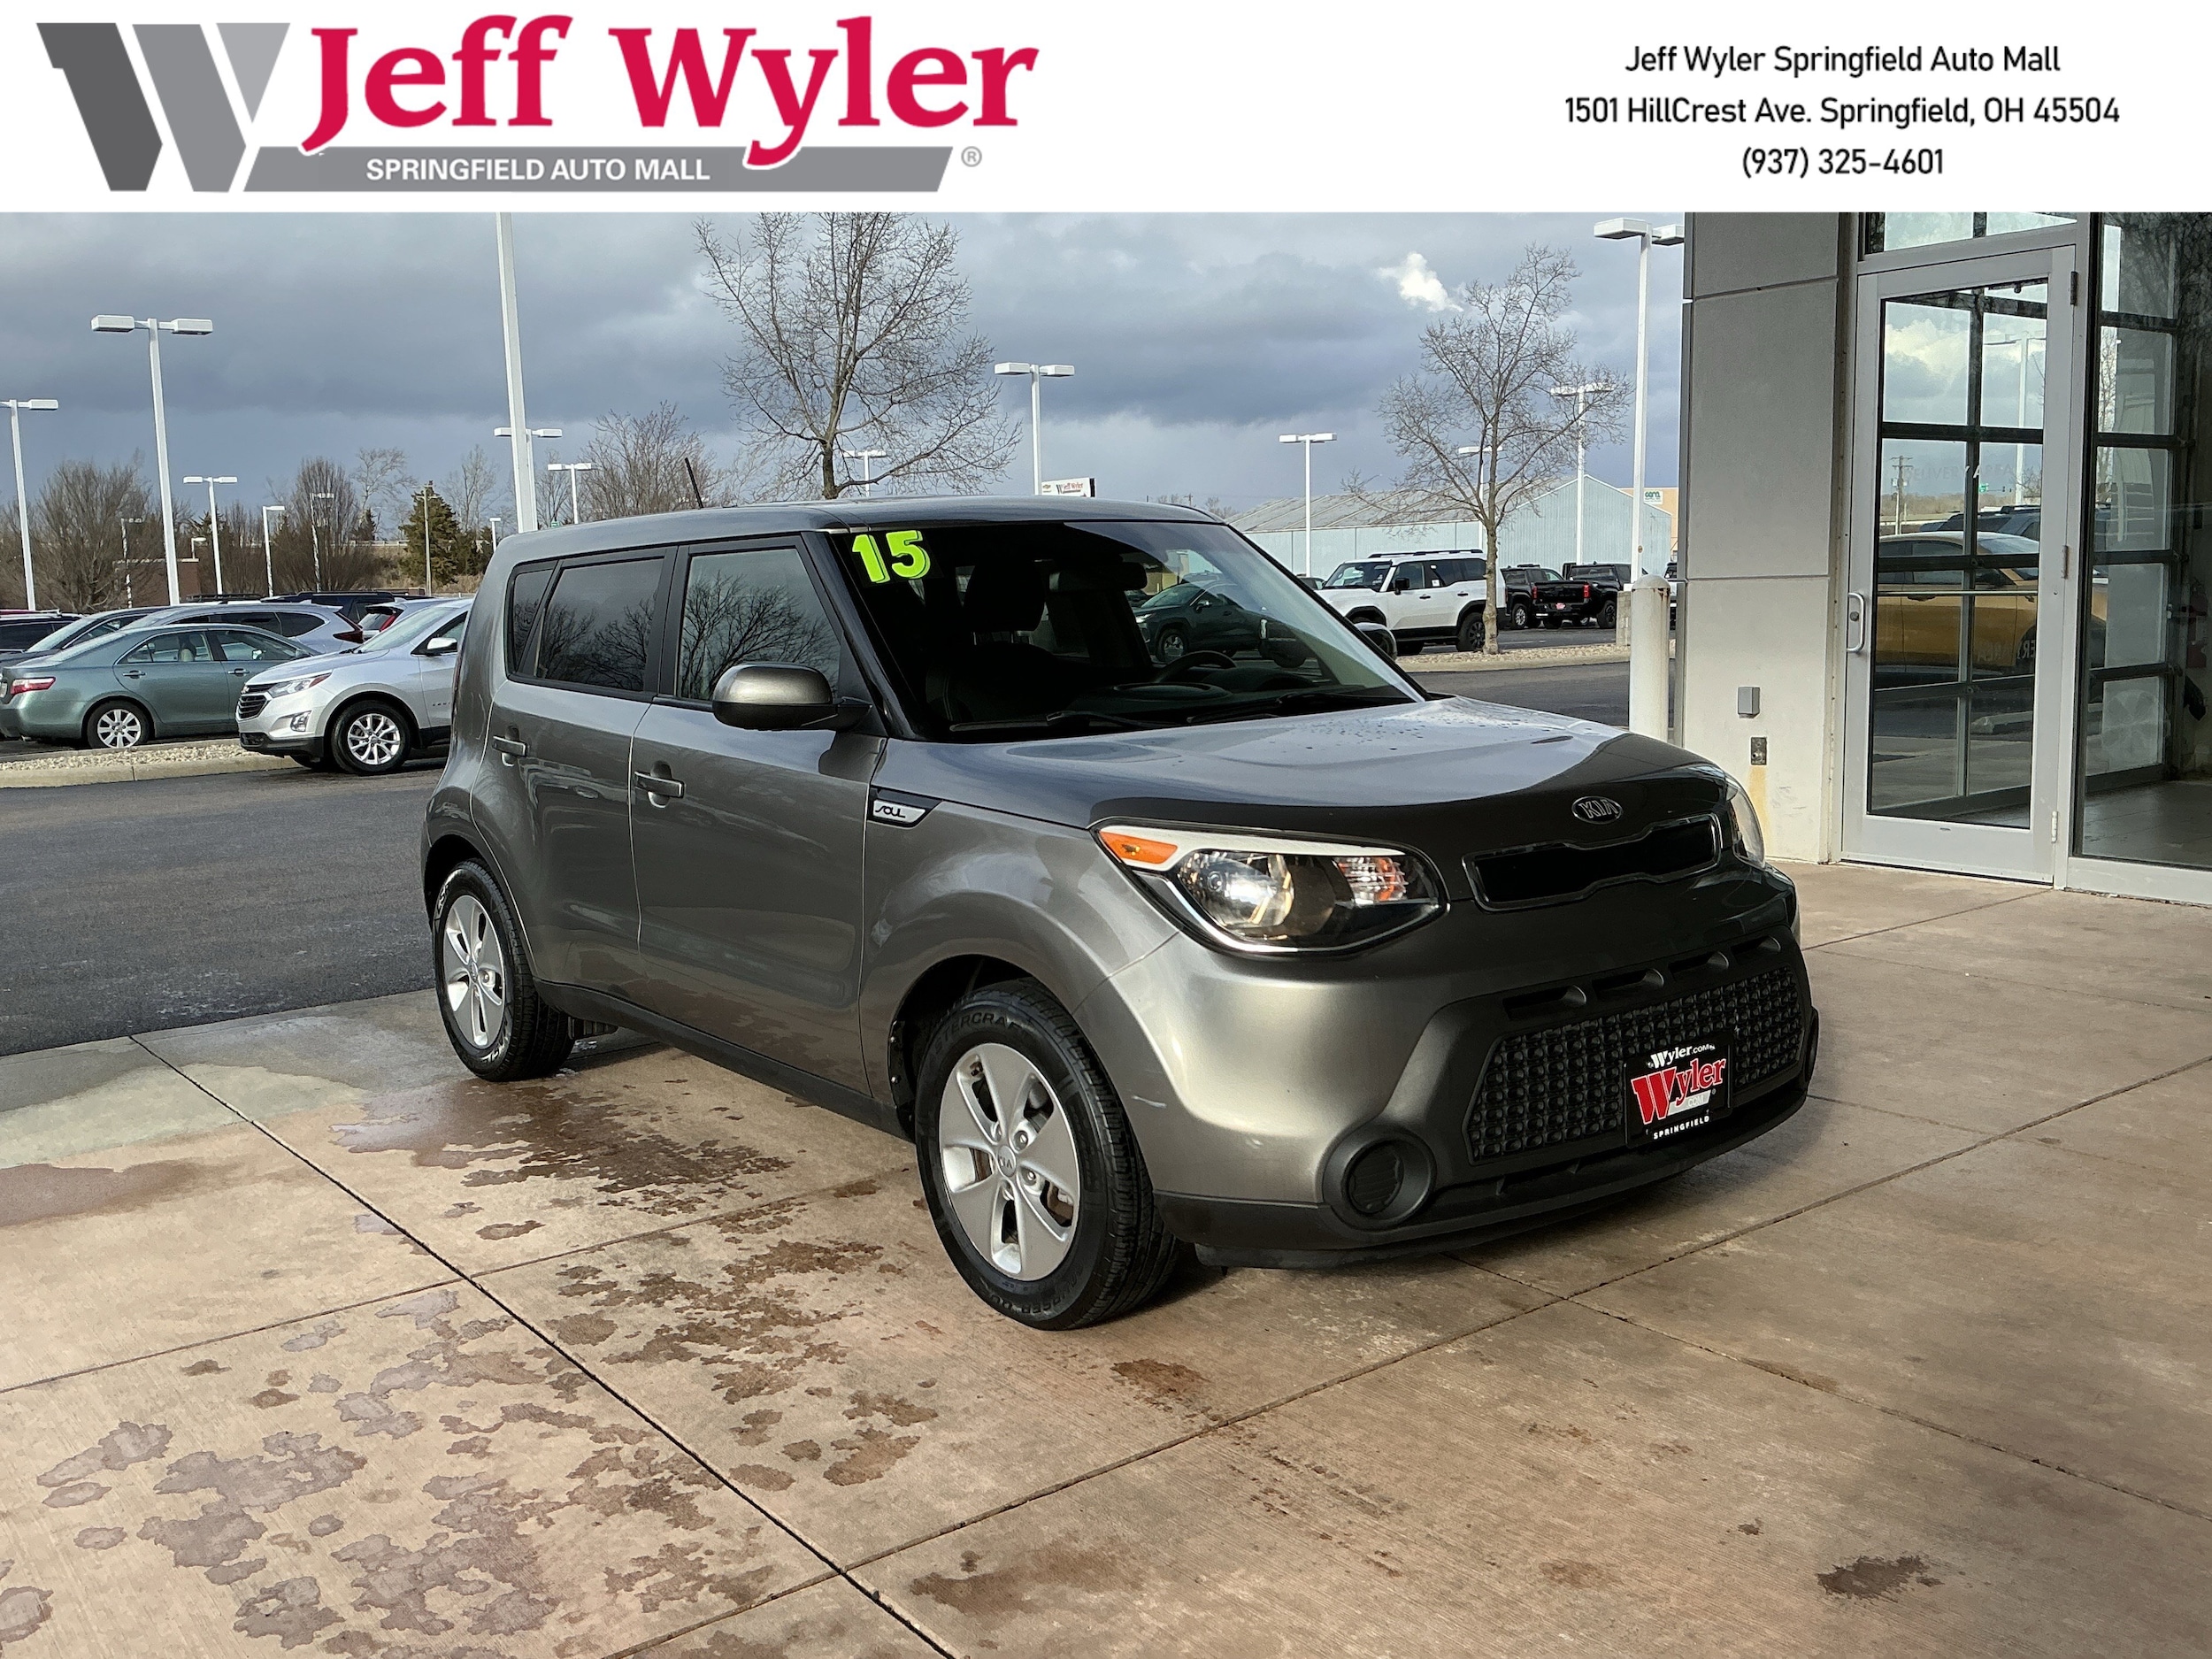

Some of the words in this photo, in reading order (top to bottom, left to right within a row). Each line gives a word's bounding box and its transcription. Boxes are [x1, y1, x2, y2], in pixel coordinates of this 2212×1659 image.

[851, 529, 931, 584] 15
[1578, 799, 1618, 818] KIA
[1631, 1057, 1727, 1125] Wyler
[1653, 1115, 1709, 1140] SPRINGFIELD
